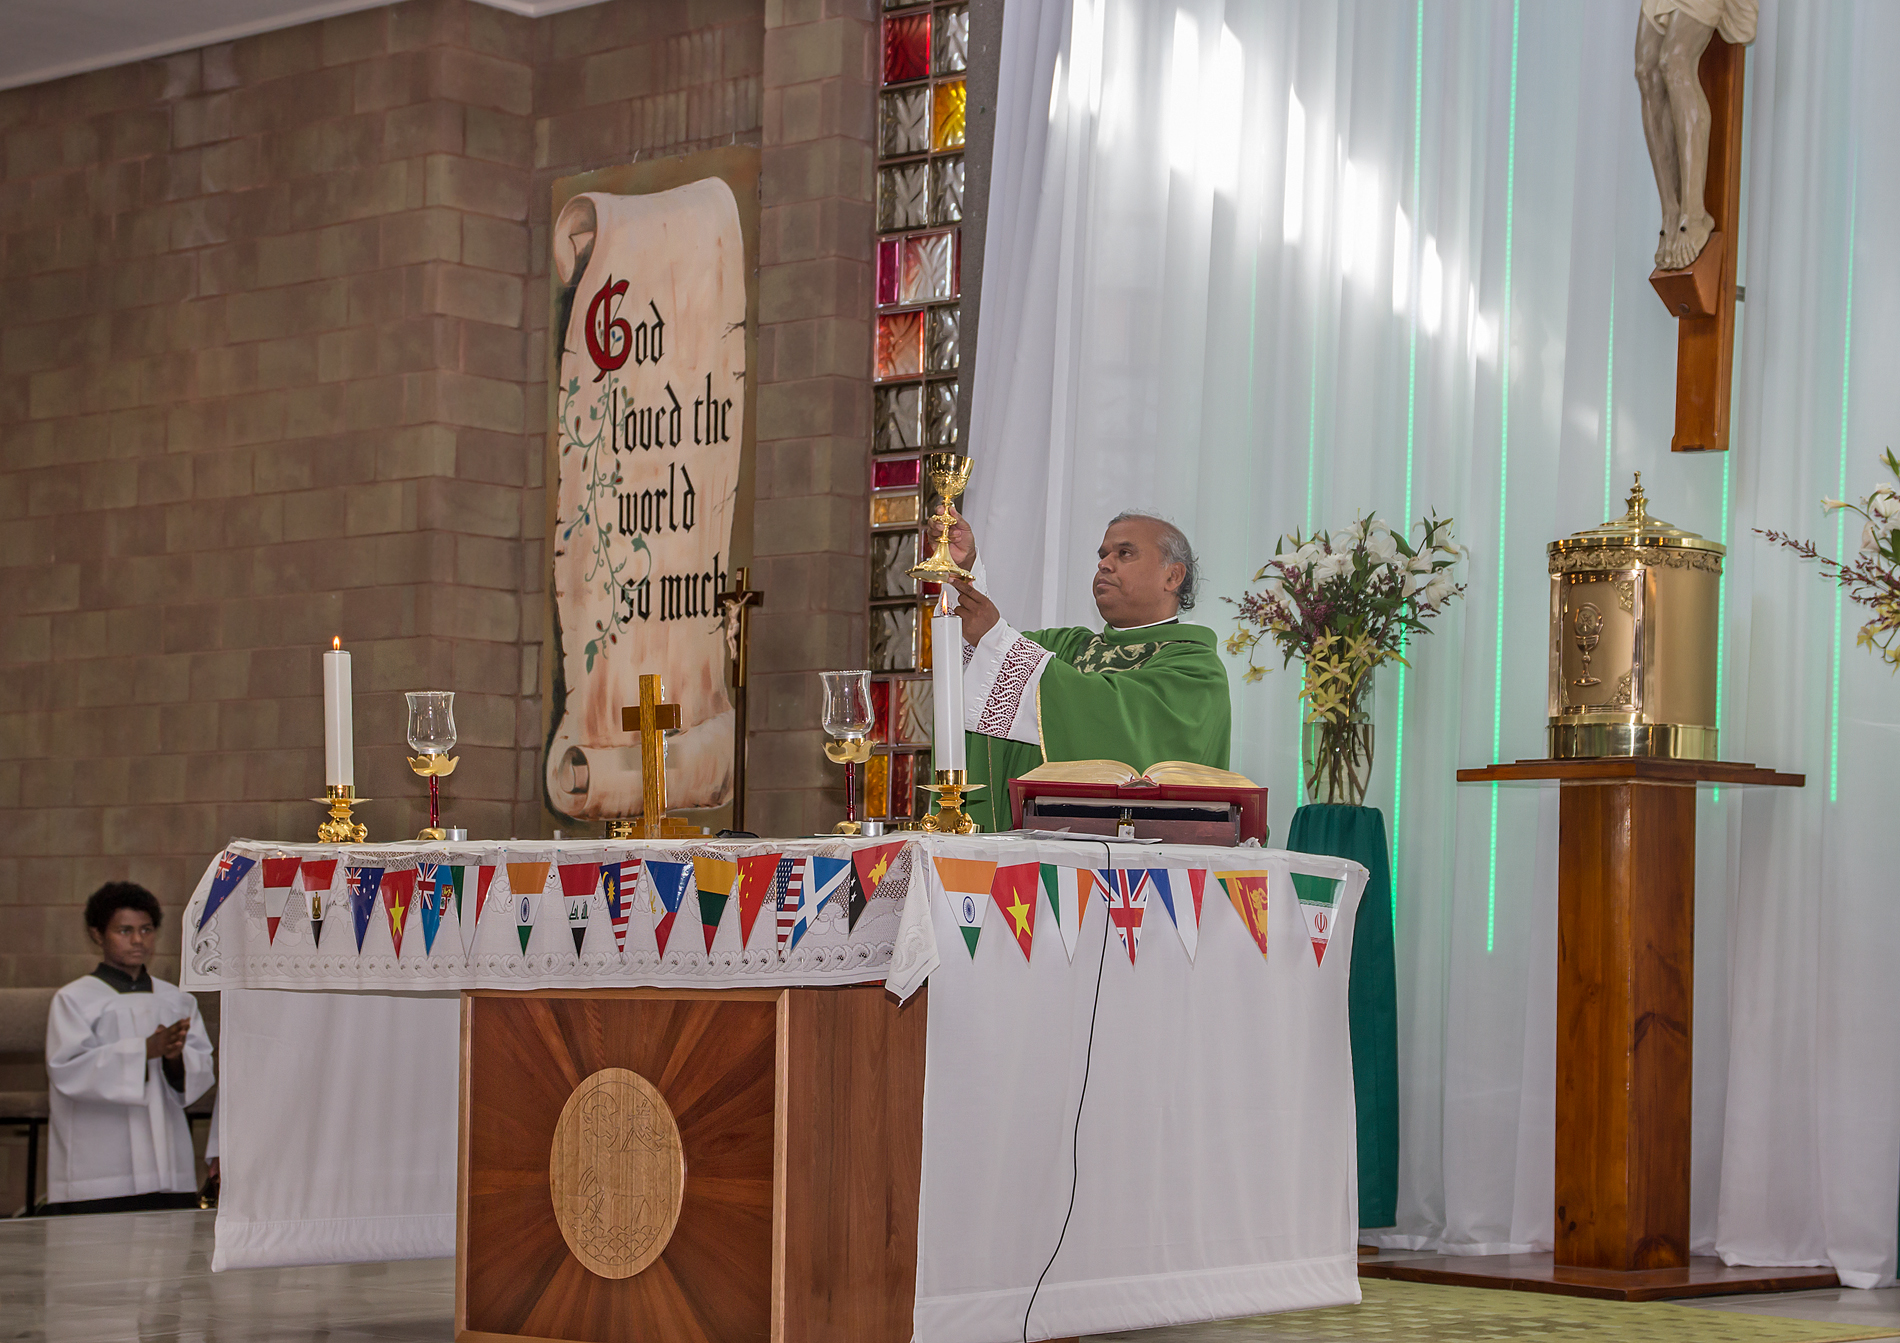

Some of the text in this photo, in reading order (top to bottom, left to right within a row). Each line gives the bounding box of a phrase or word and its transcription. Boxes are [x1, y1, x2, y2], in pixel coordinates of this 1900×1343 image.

[585, 273, 665, 383] God
[611, 372, 733, 455] loved the
[618, 462, 696, 536] world
[620, 551, 727, 625] so much
